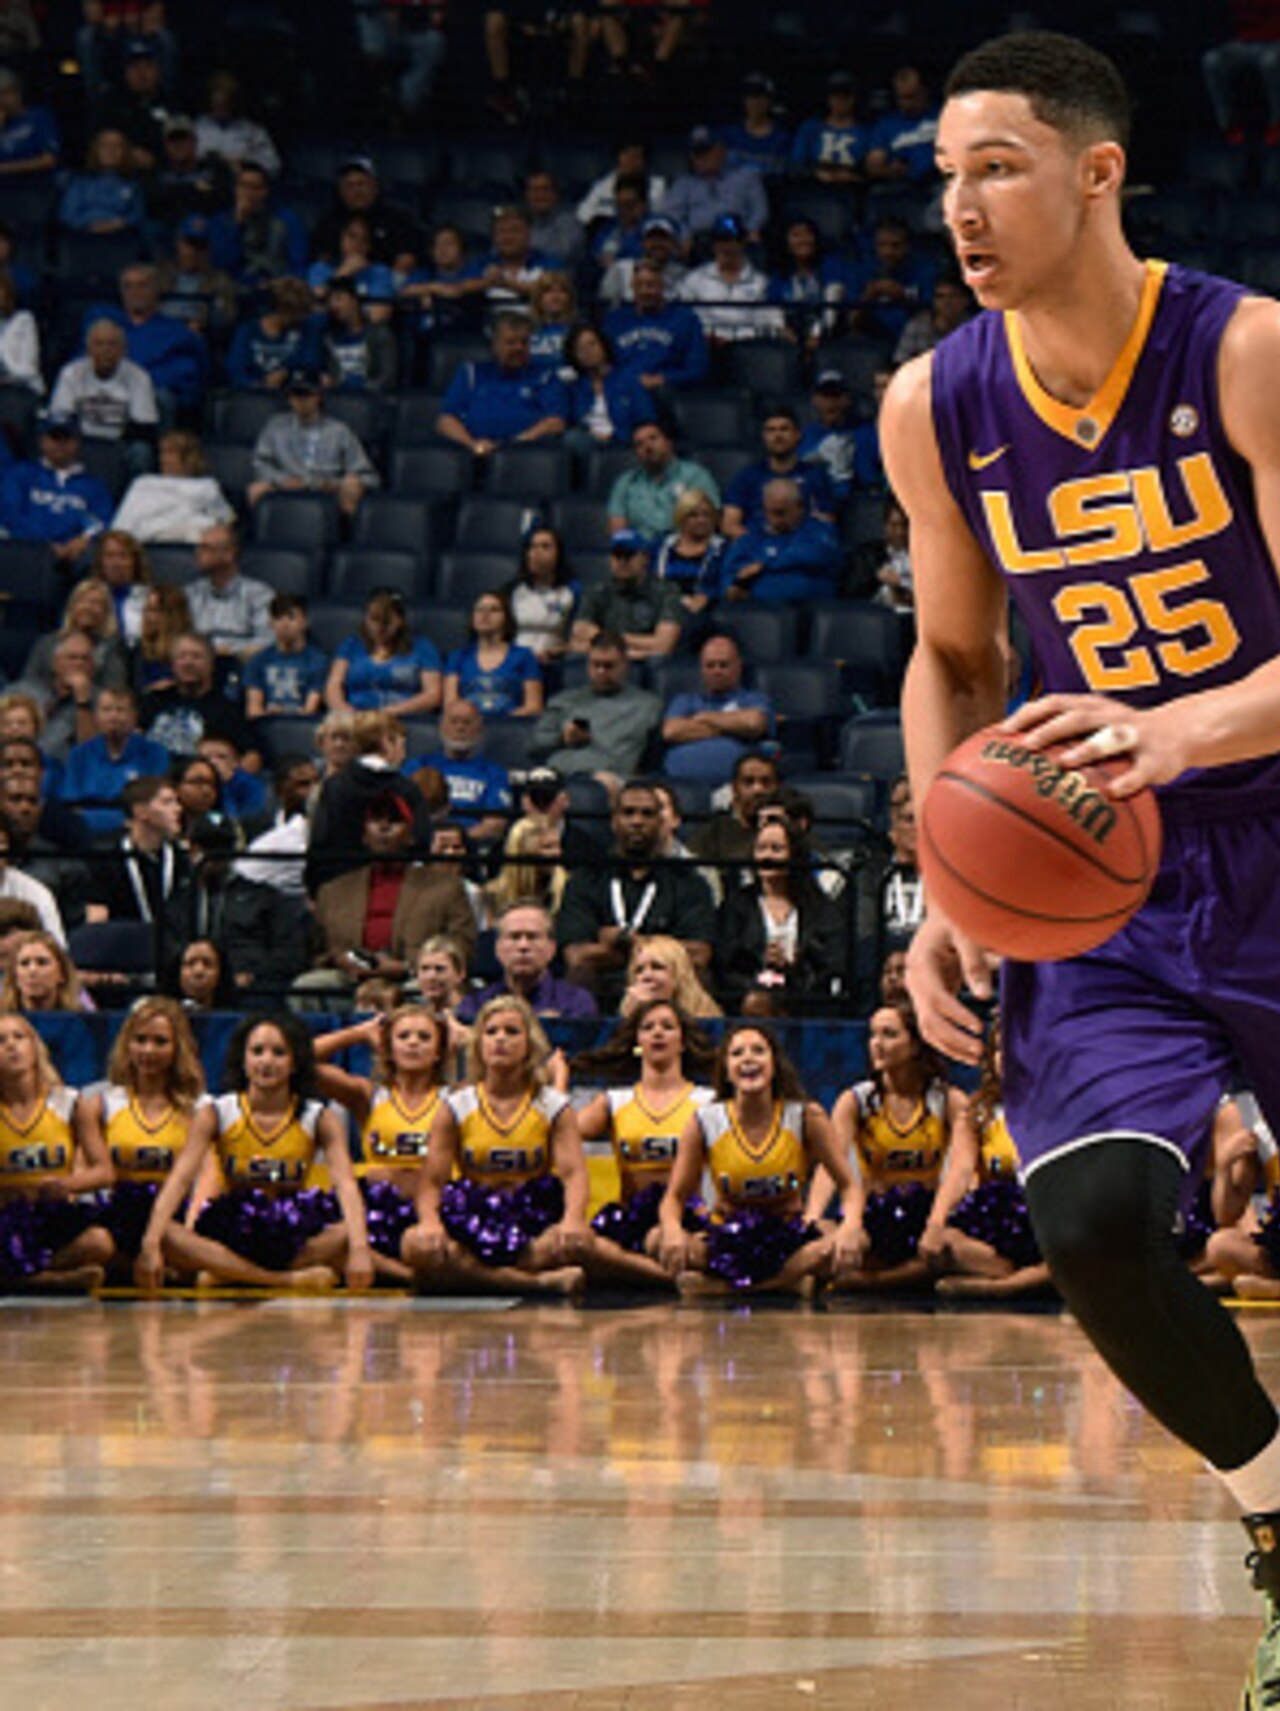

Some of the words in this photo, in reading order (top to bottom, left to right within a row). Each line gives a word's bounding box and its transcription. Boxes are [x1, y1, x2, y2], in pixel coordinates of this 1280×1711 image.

[818, 131, 857, 167] K
[980, 452, 1233, 574] LSU
[1052, 560, 1241, 691] 25
[980, 740, 1117, 845] Wilson
[369, 1131, 429, 1157] LS
[464, 1147, 545, 1173] LSU
[865, 1148, 941, 1171] LSU
[226, 1155, 304, 1183] LSU
